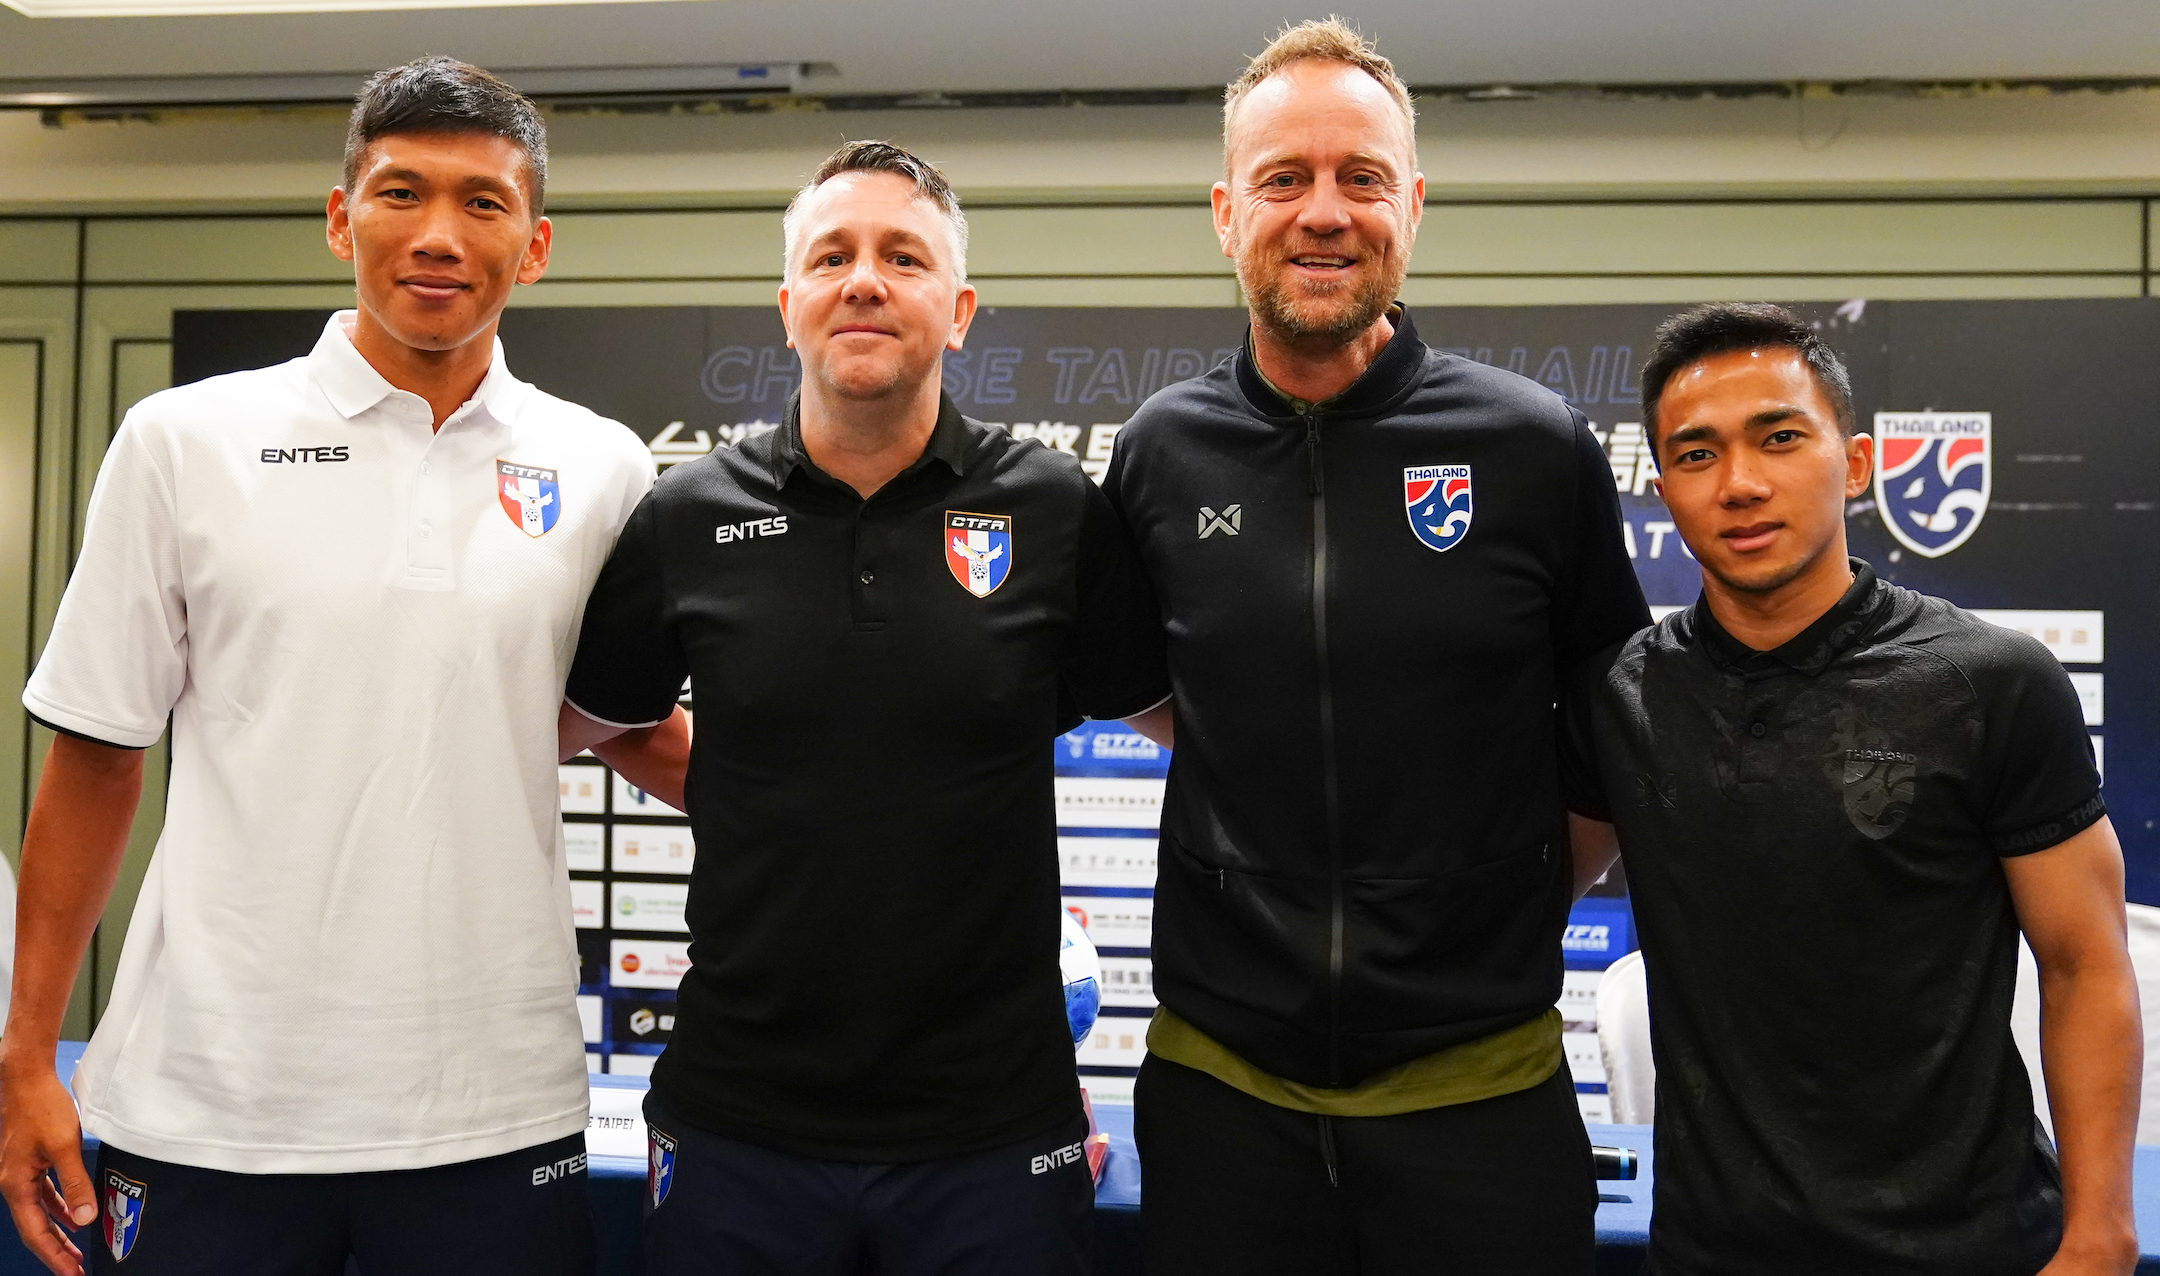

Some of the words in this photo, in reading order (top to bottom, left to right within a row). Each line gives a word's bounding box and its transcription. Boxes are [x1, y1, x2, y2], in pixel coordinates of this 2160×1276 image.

[1882, 419, 1984, 434] THAILAND
[260, 445, 349, 463] ENTES
[501, 464, 554, 481] CTFA
[1406, 467, 1468, 481] THAILAND
[715, 515, 789, 543] ENTES
[950, 516, 1005, 531] CTFA
[1564, 925, 1610, 939] TFA
[597, 1116, 634, 1131] TAIPEI
[650, 1129, 675, 1152] CTFA
[1031, 1141, 1082, 1175] ENTES
[531, 1152, 588, 1186] ENTES
[109, 1175, 142, 1198] CTFA
